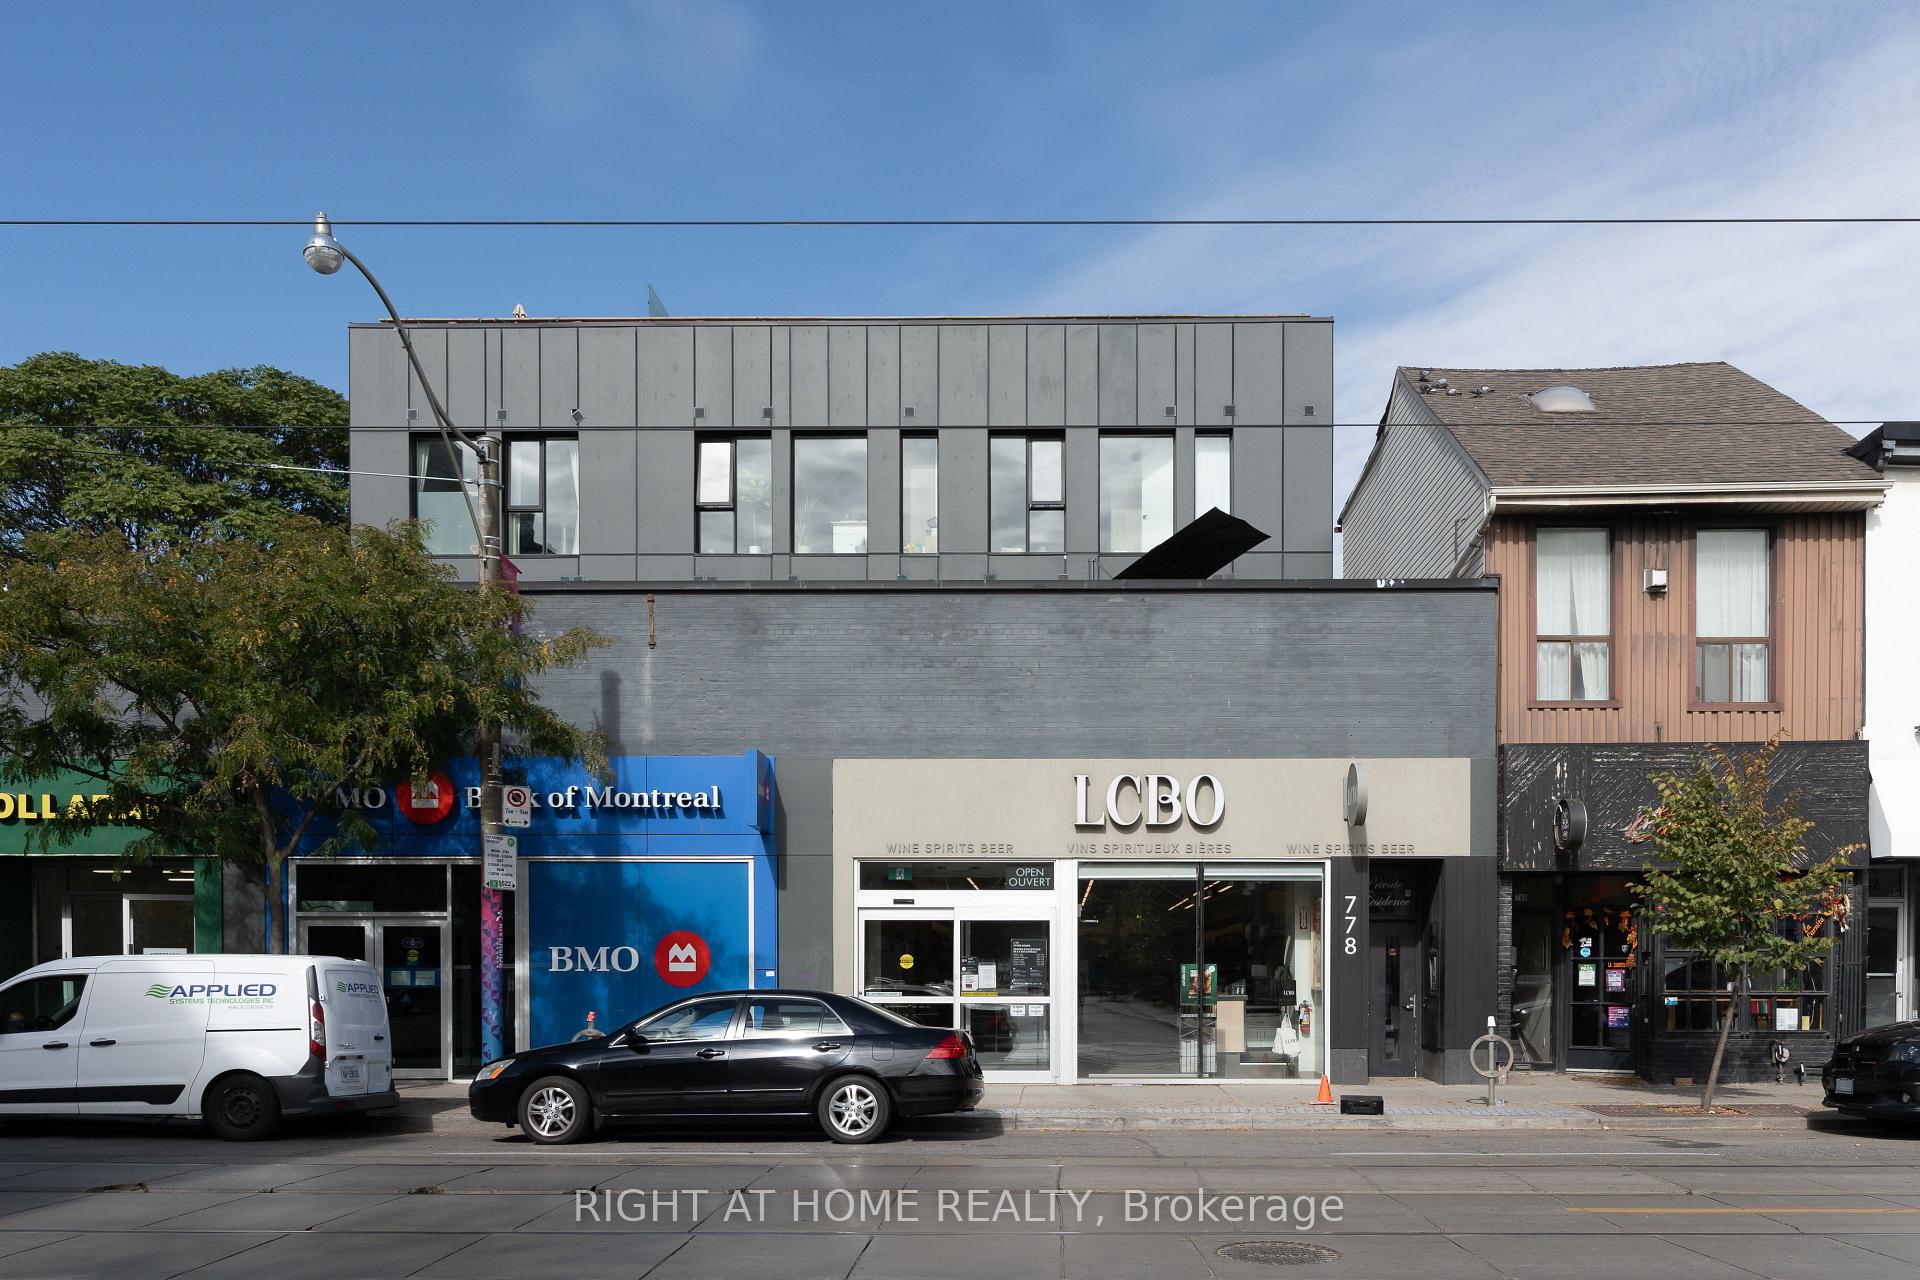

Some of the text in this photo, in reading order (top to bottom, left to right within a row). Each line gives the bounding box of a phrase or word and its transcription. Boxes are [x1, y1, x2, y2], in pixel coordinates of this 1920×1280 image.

[547, 785, 577, 808] of
[584, 785, 721, 809] Montreal
[1073, 774, 1225, 826] LCBO
[887, 843, 1014, 854] WINE SPIRITS BEER
[1067, 840, 1232, 854] VINS SPIRITUEUX BIÈRES
[1287, 843, 1415, 854] WINE SPIRITS BEER
[1015, 867, 1044, 877] OPEN
[1008, 877, 1051, 887] OUVERT
[1368, 876, 1403, 889] Private
[1344, 896, 1357, 955] 778
[548, 946, 640, 972] BMO
[170, 983, 277, 998] APPLIED
[347, 982, 379, 995] APPLIED
